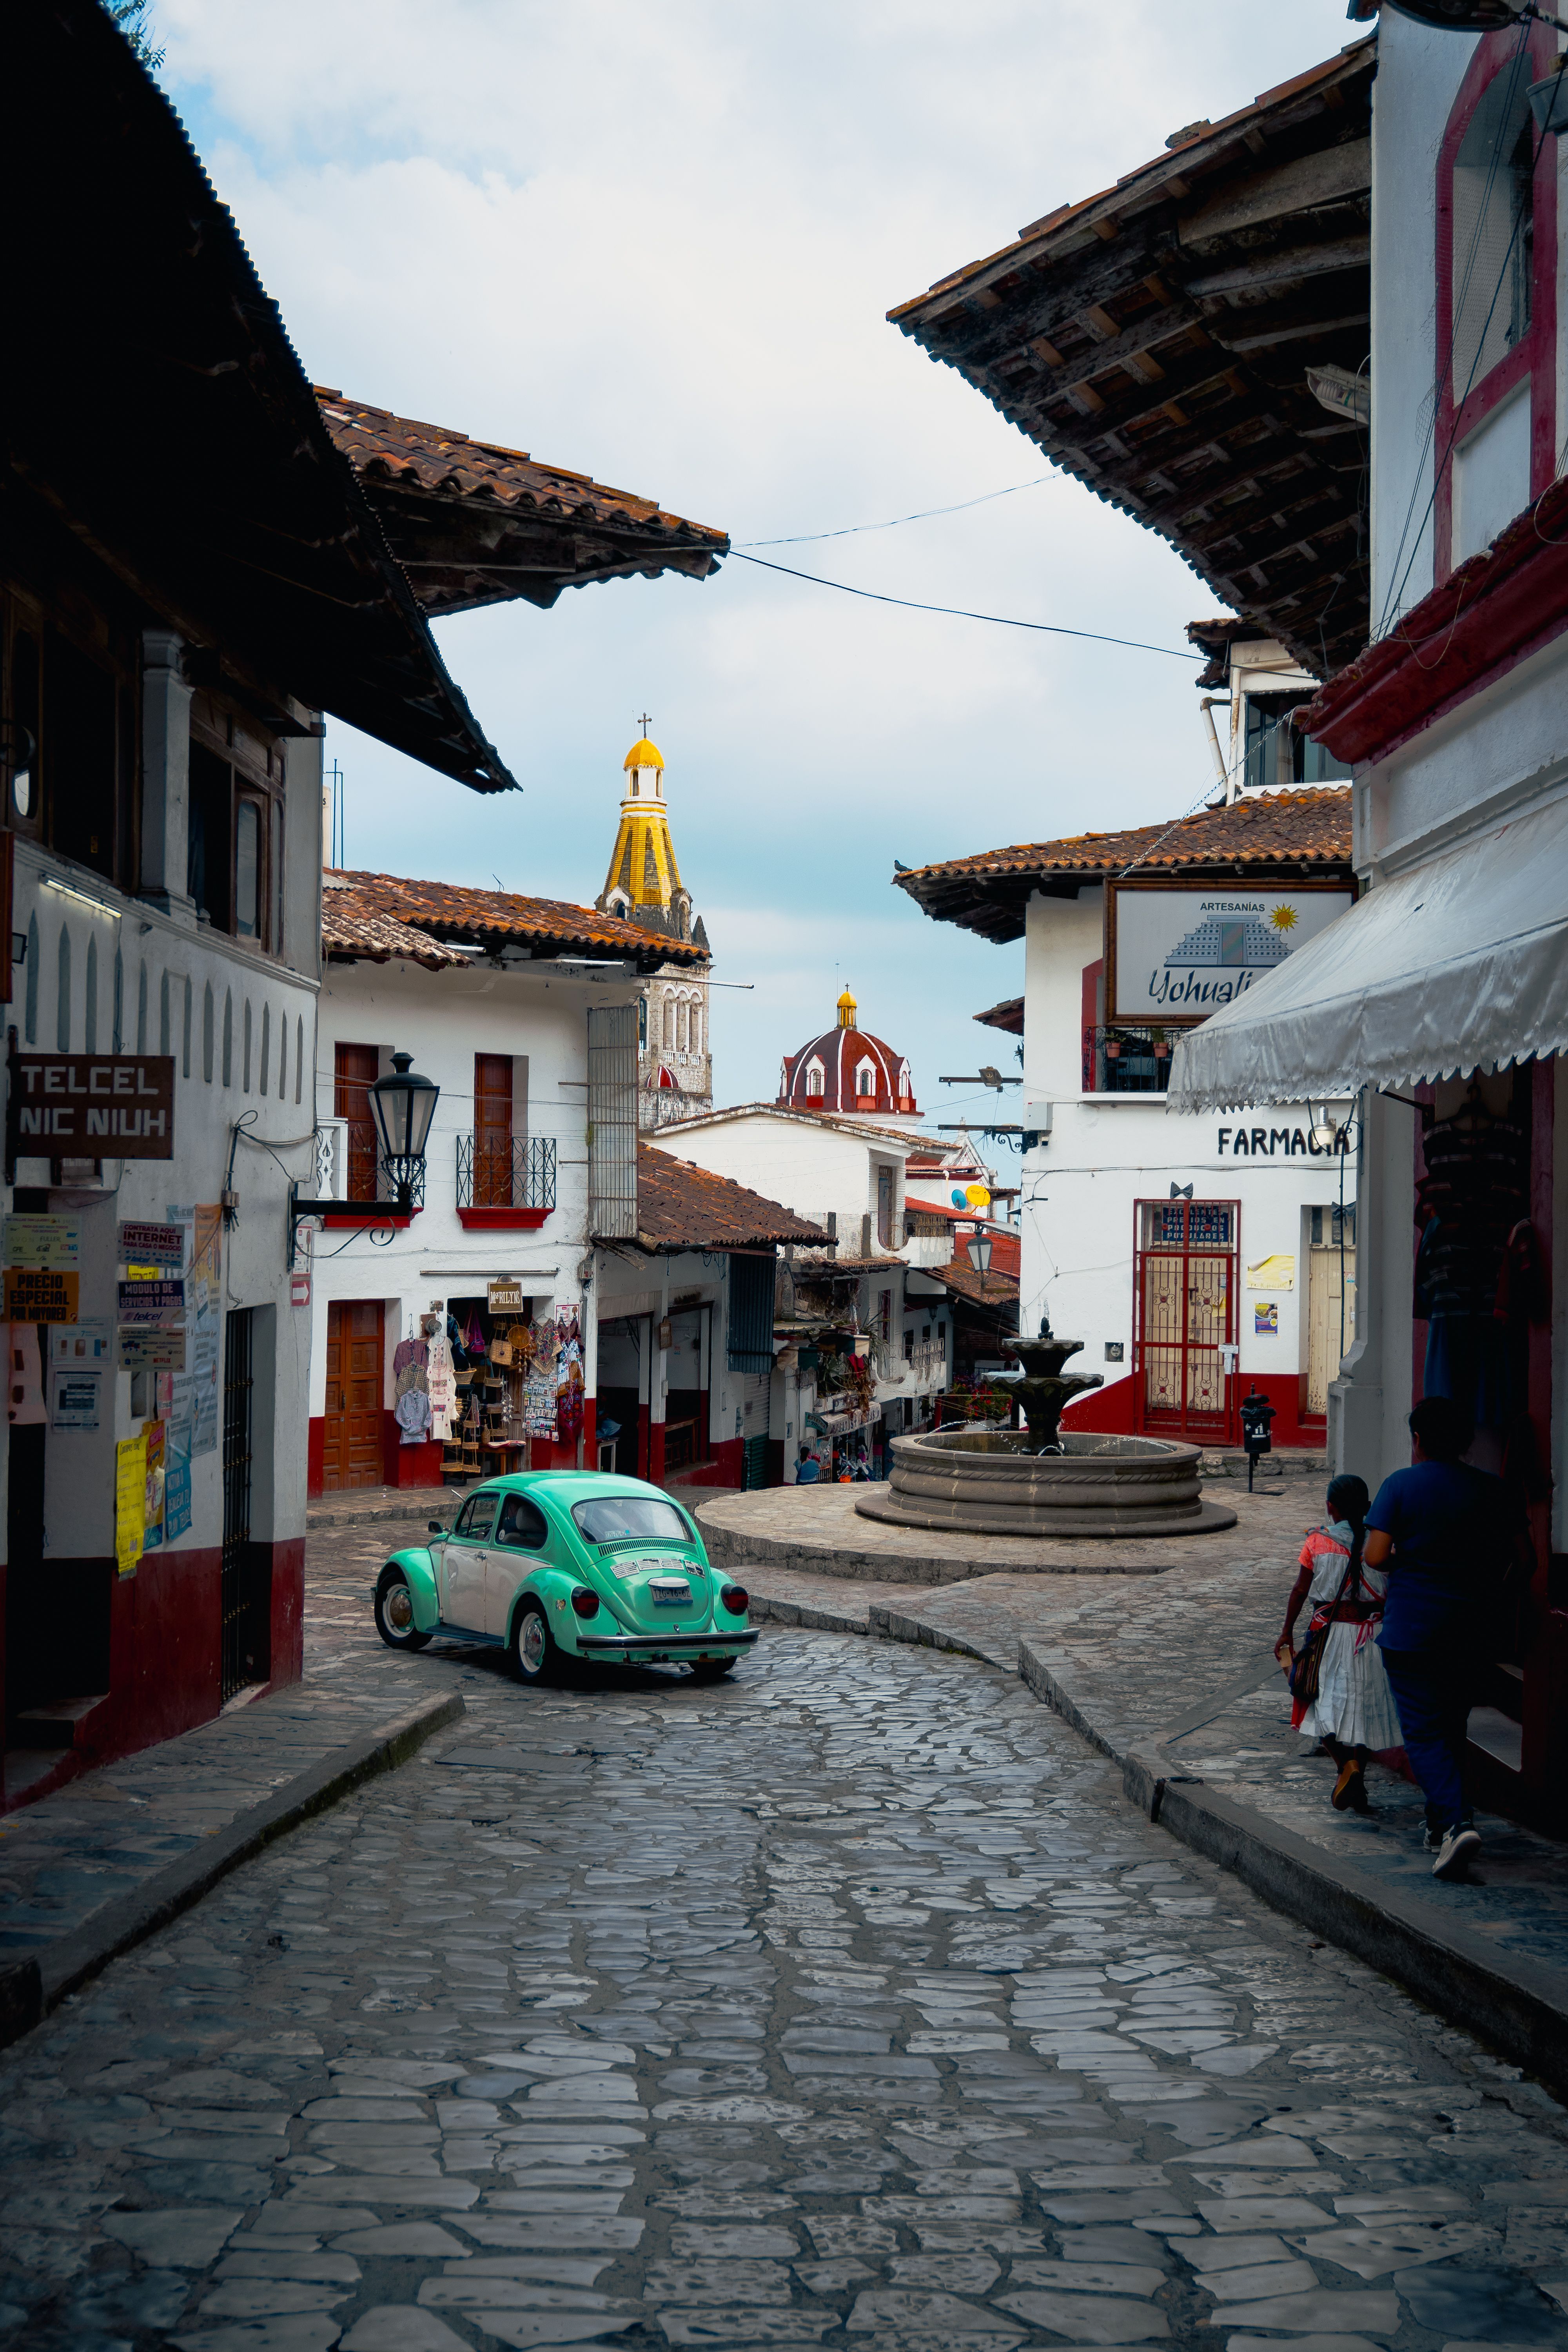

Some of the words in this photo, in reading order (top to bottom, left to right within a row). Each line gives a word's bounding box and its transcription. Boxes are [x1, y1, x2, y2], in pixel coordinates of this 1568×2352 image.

[1200, 902, 1265, 912] ARTESANÍAS
[21, 1066, 159, 1094] TELCEL
[20, 1107, 74, 1135] NIC
[87, 1108, 165, 1136] NIUH
[123, 1231, 182, 1244] INTERNET
[18, 1275, 63, 1289] PRECIO
[125, 1283, 160, 1294] MODULO
[162, 1283, 174, 1293] DE
[11, 1290, 69, 1305] ESPECIAL
[121, 1296, 153, 1308] SERVICIOS
[155, 1296, 160, 1307] Y
[162, 1296, 183, 1306] PAGOS
[11, 1306, 26, 1320] POR
[29, 1307, 67, 1320] MAYOREO
[133, 1312, 163, 1321] telcel
[653, 1588, 691, 1598] TZG-76-62
